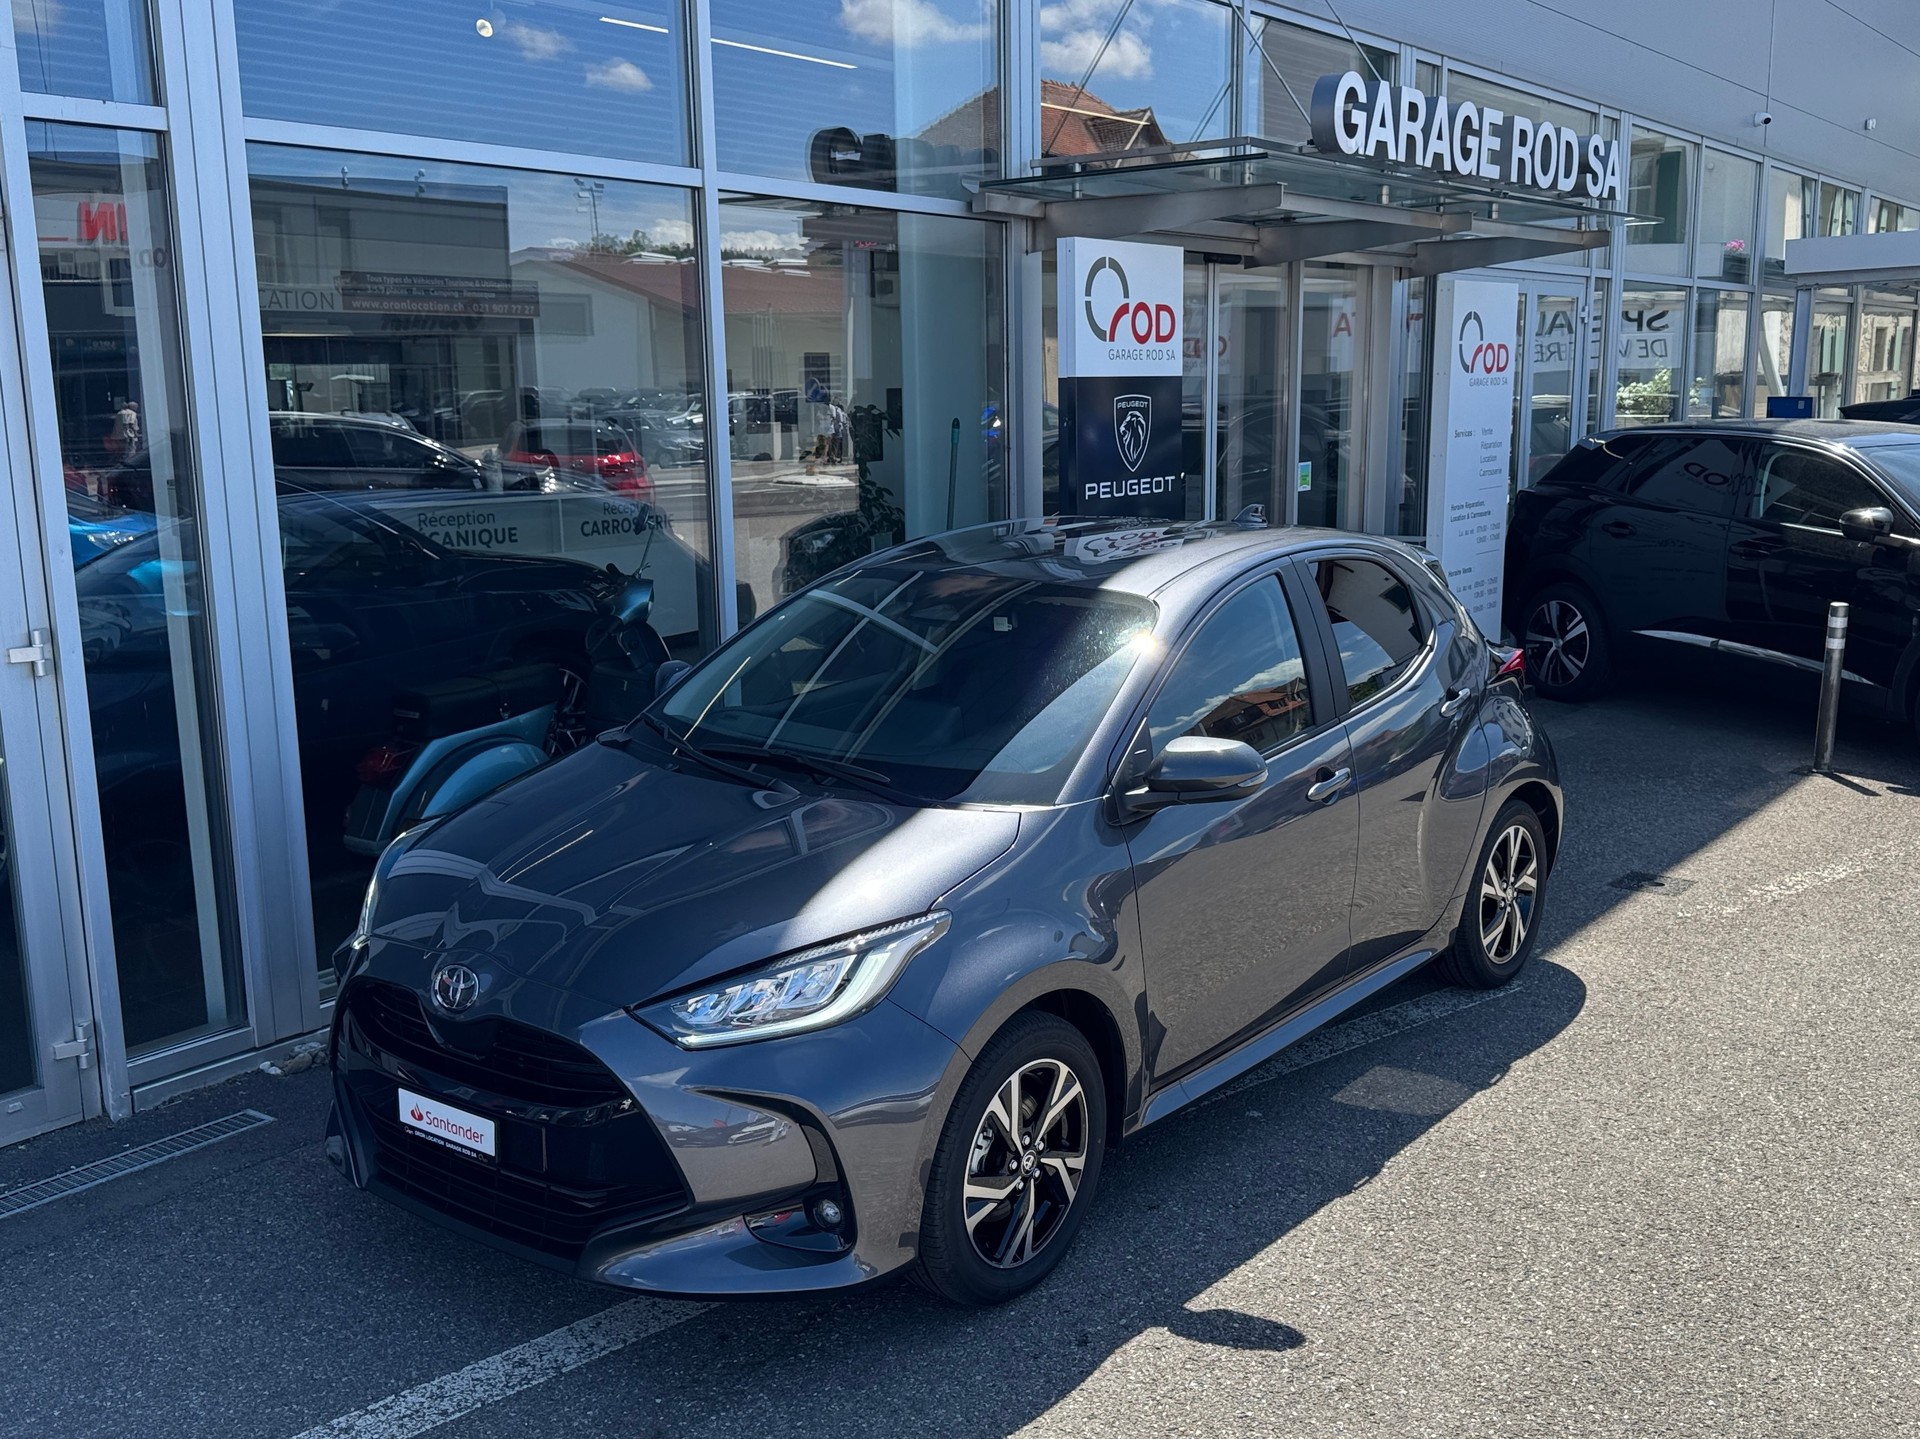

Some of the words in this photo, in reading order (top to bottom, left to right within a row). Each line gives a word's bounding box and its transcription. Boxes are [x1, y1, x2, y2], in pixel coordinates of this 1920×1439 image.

[1334, 71, 1503, 180] GARAGE
[1510, 115, 1580, 192] ROD
[1586, 134, 1622, 201] SA
[1108, 348, 1143, 361] GARAGE
[1146, 349, 1164, 361] ROD
[1166, 349, 1176, 361] SA
[1469, 376, 1489, 387] GARAGE
[1490, 376, 1500, 386] ROD
[1502, 375, 1508, 385] SA
[1117, 401, 1149, 410] PEUGEOT
[1085, 476, 1176, 500] PEUGEOT
[417, 510, 496, 529] Réception
[426, 1110, 484, 1145] Santander
